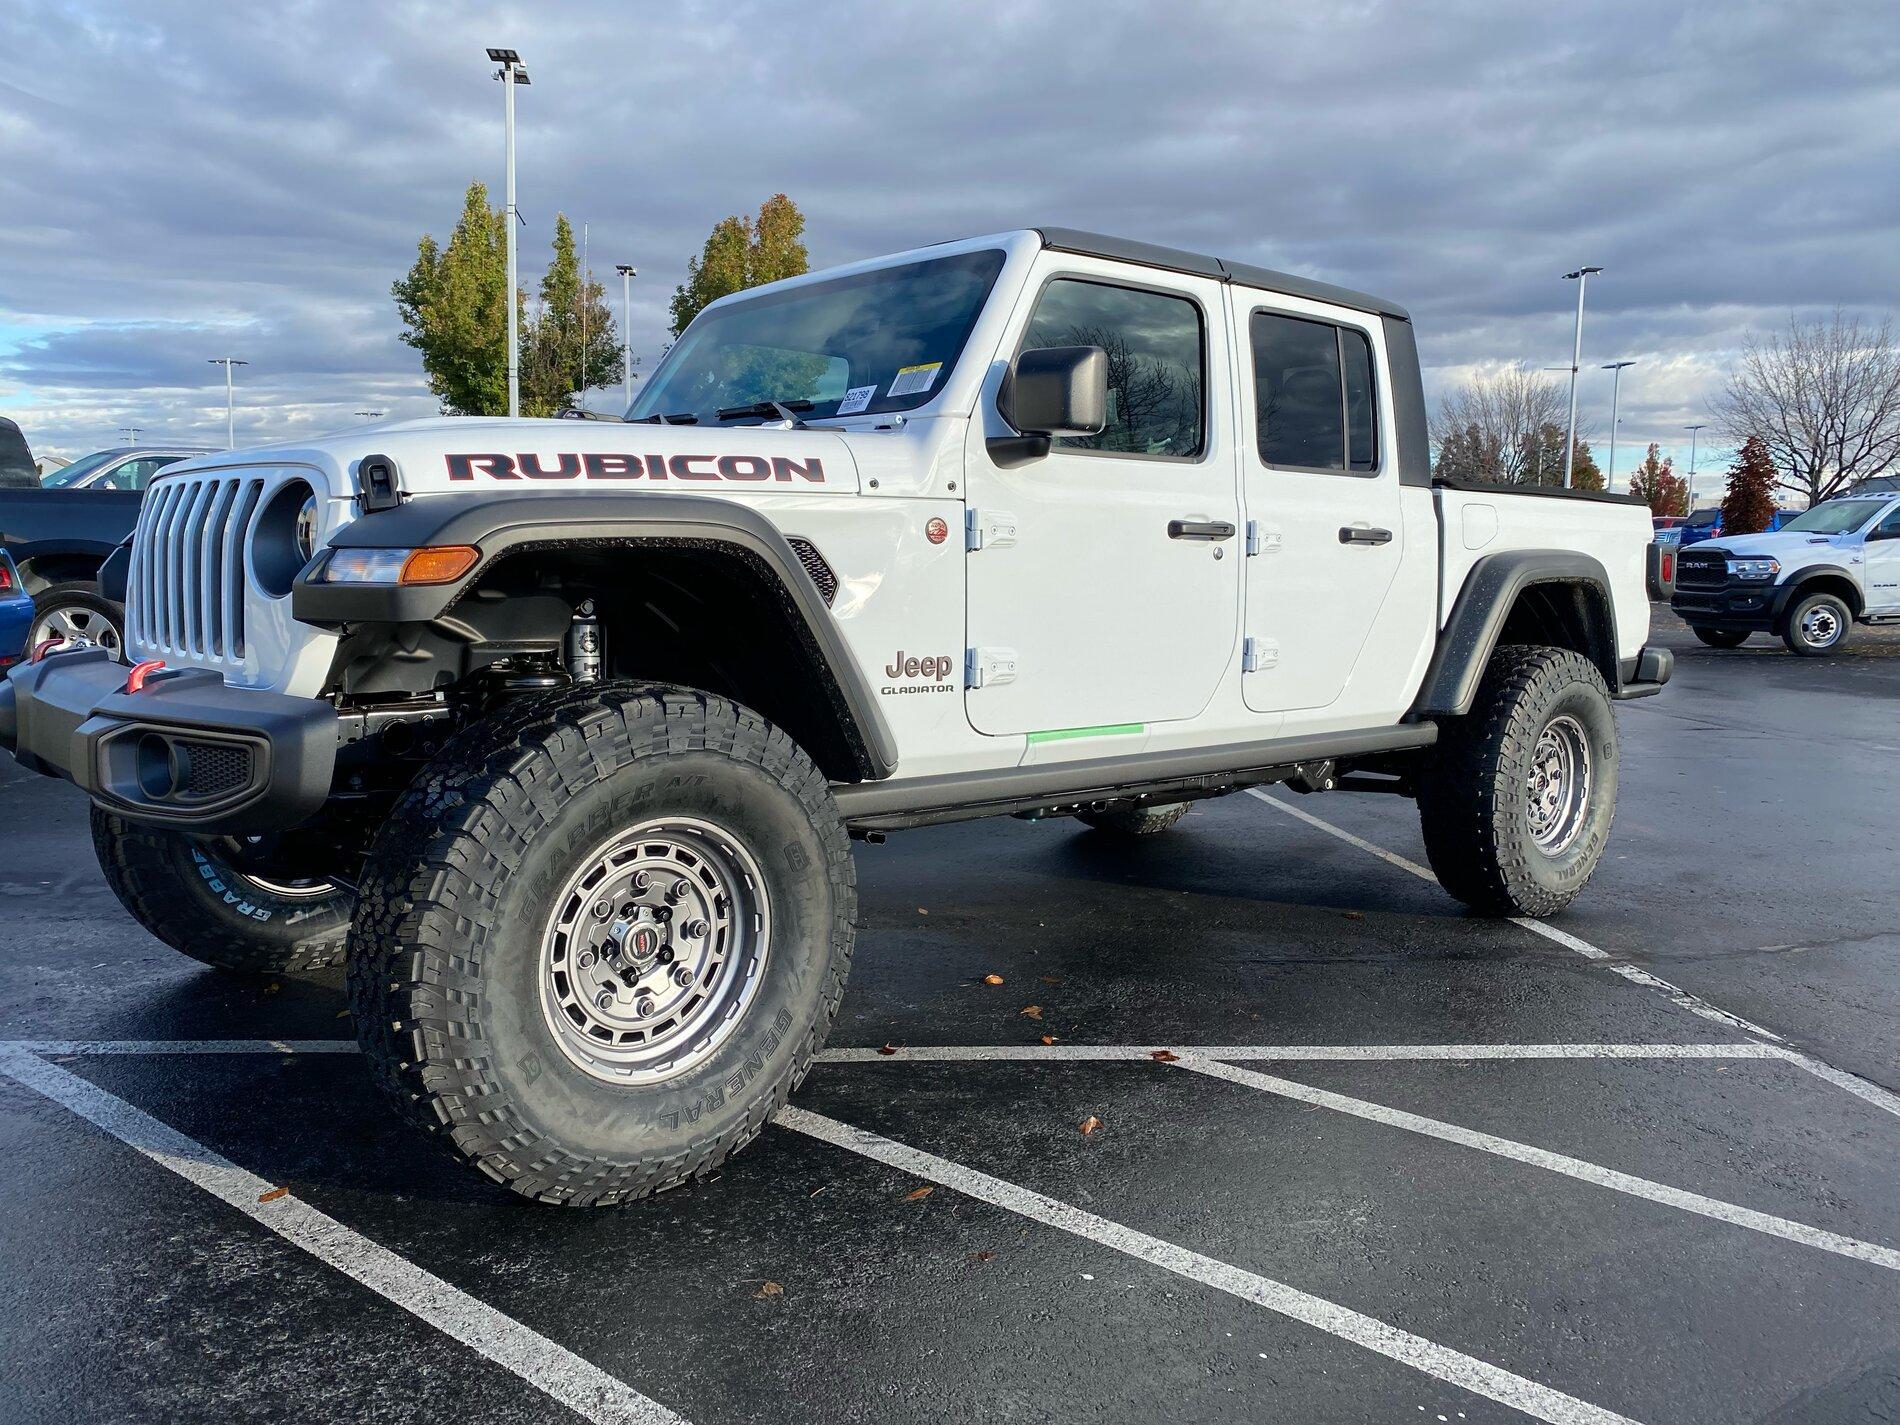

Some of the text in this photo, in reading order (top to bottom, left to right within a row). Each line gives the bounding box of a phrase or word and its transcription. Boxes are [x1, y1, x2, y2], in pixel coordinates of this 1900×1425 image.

[444, 453, 825, 483] RUBICON
[885, 650, 953, 682] Jeep
[880, 684, 955, 696] GLADIATOR
[519, 781, 656, 926] GRABBER
[659, 1007, 794, 1132] GENERAL
